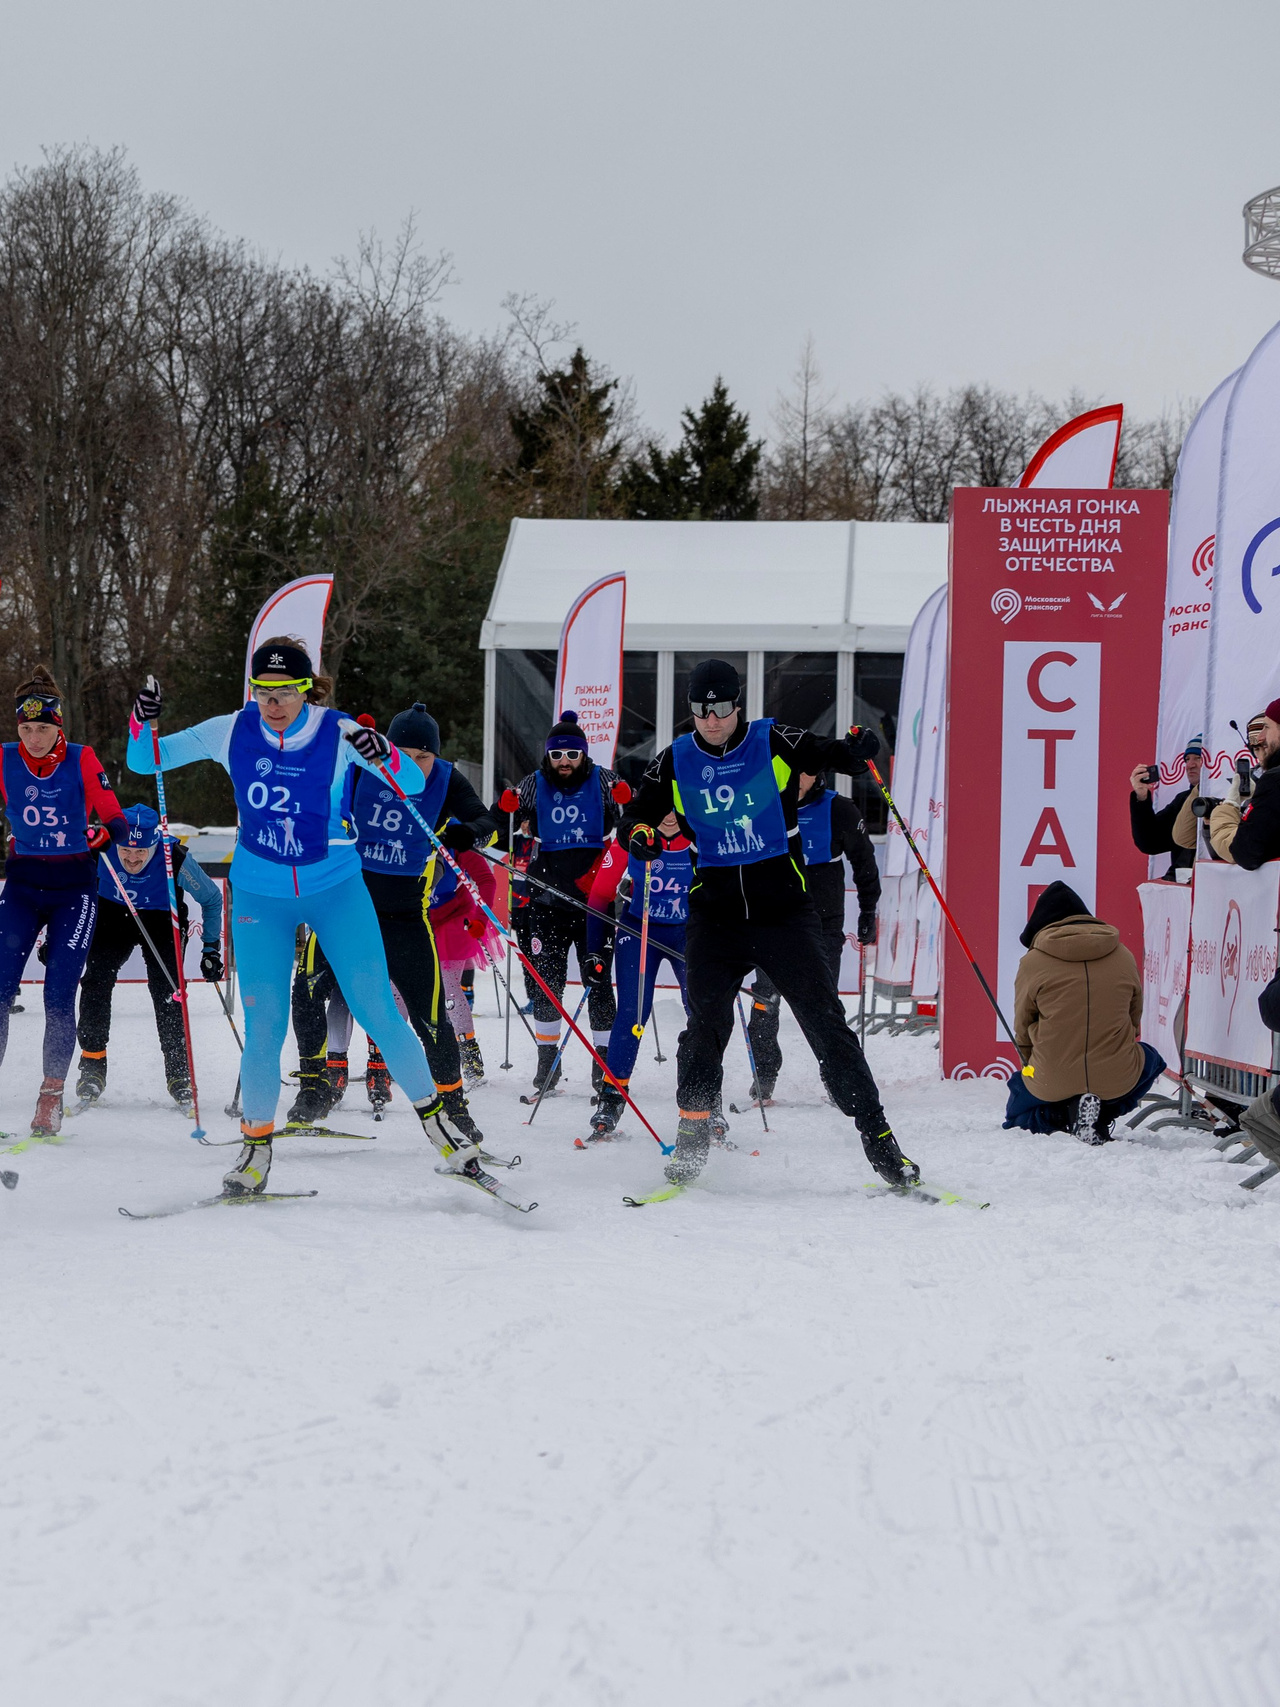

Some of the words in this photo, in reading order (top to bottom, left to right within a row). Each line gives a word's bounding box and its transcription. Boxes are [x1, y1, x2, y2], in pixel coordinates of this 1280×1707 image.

[982, 498, 1071, 514] ЛЫЖНАЯ
[1077, 499, 1141, 515] ГОНКА
[1000, 518, 1012, 533] В
[1016, 518, 1076, 534] ЧЕСТЬ
[1079, 519, 1121, 536] ДНЯ
[998, 537, 1123, 554] ЗАЩИТНИКА
[1005, 556, 1115, 573] ОТЕЧЕСТВА
[1024, 595, 1071, 603] Московский
[1024, 604, 1063, 612] транспорт
[247, 781, 291, 813] 02
[699, 784, 735, 815] 19
[1020, 650, 1078, 930] СТА
[22, 805, 59, 827] 03
[367, 803, 403, 832] 18
[551, 804, 579, 824] 09
[649, 876, 681, 894] 04
[67, 894, 89, 950] Московский
[81, 901, 96, 949] транспорт
